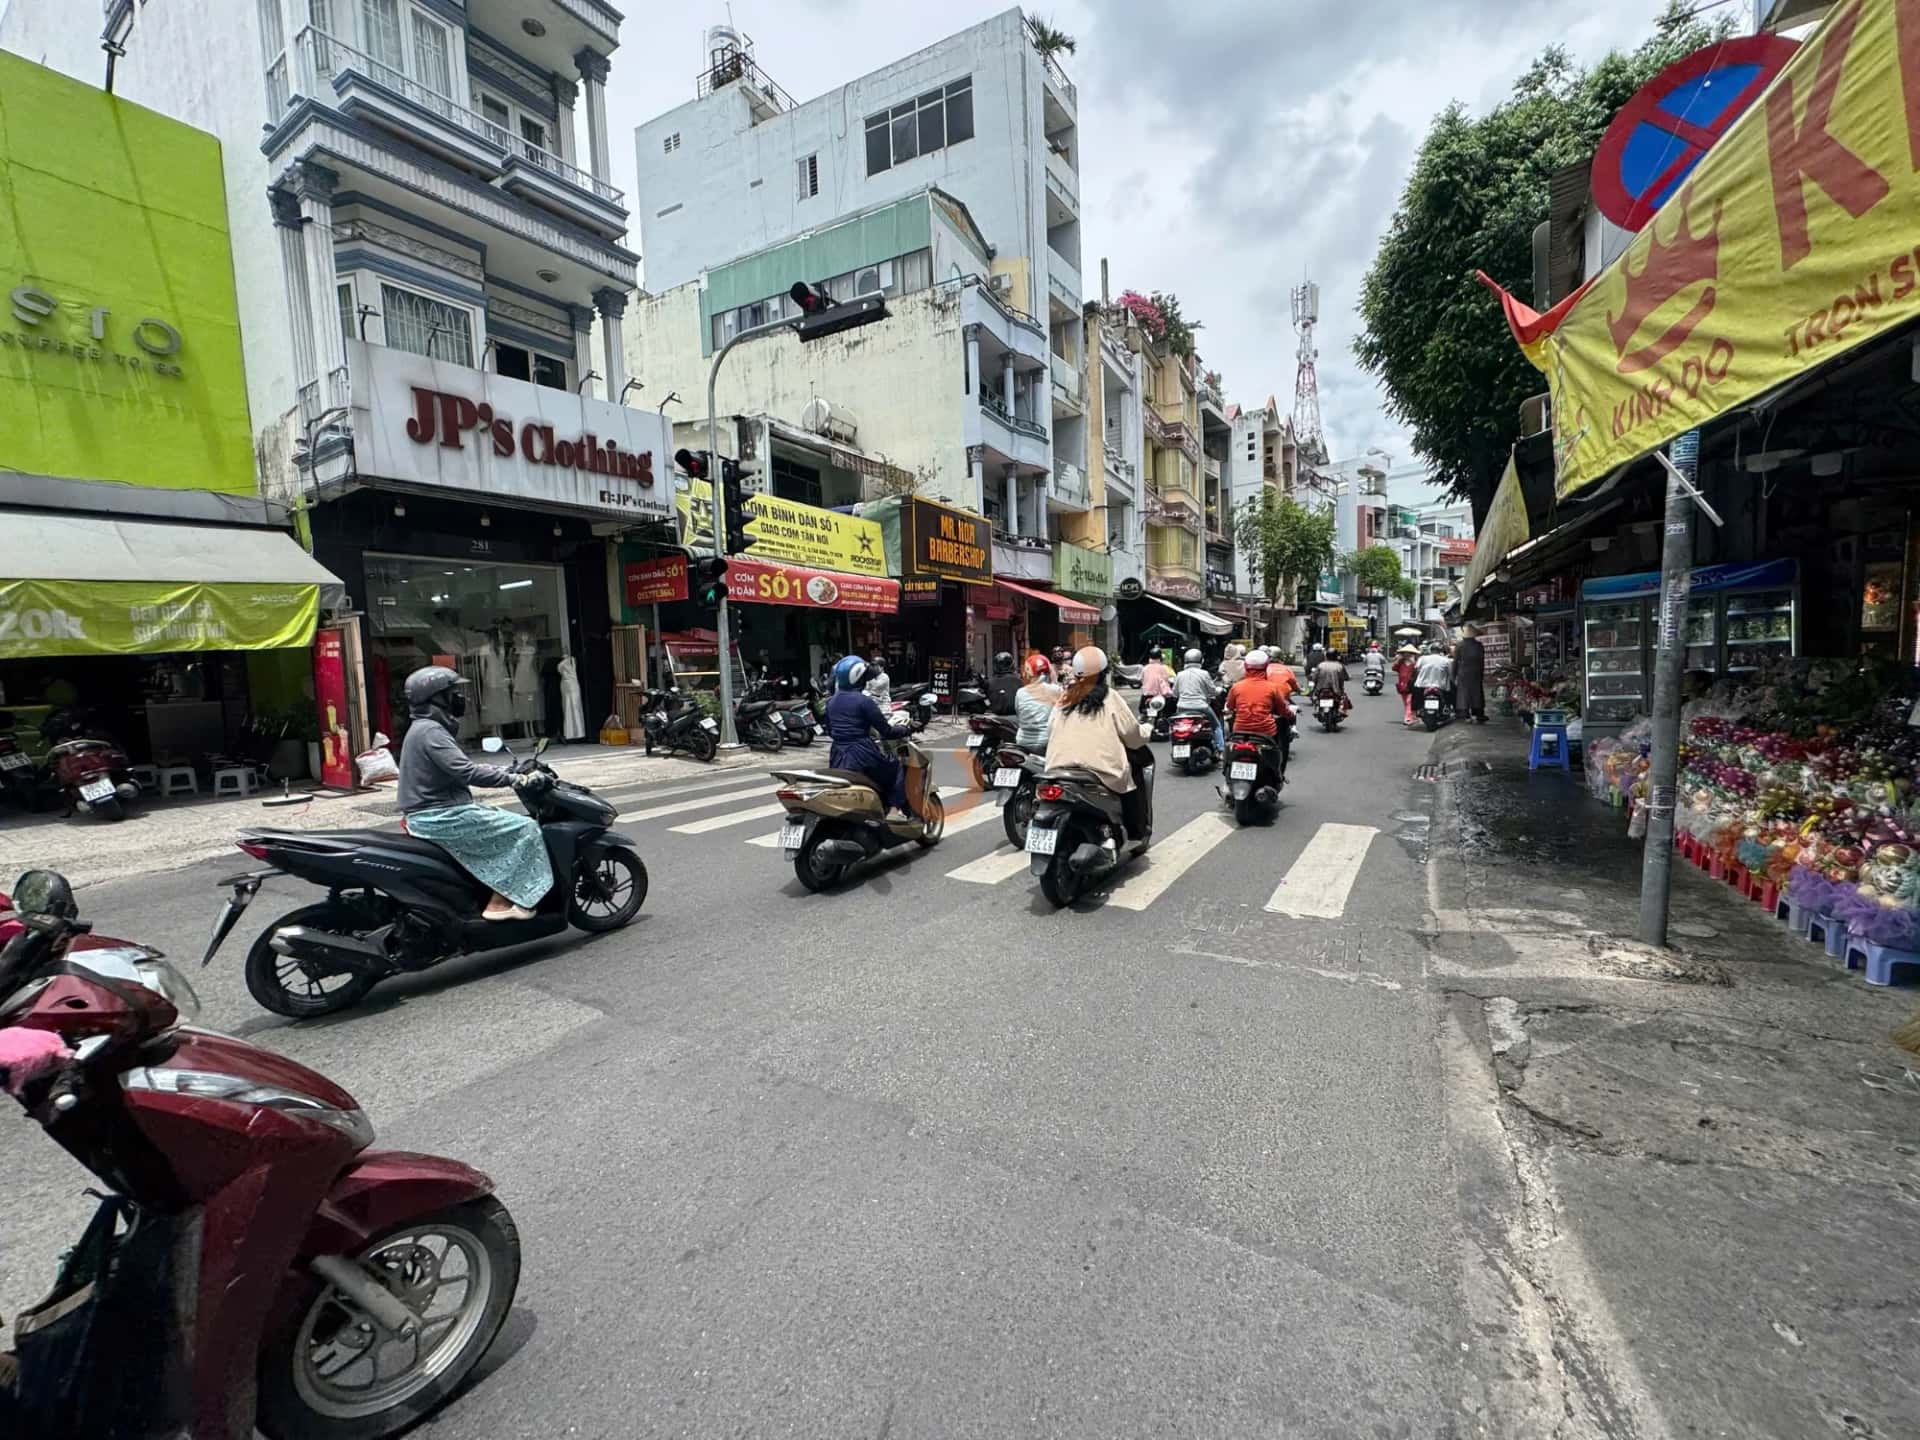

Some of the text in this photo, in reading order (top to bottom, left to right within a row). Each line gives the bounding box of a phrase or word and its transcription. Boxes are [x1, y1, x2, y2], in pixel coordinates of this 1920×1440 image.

[520, 423, 655, 488] Clothing
[760, 522, 780, 535] GIAO
[771, 504, 797, 523] BÌNH
[798, 511, 818, 529] DÂN
[820, 515, 832, 532] SỐ
[834, 521, 840, 534] 1
[929, 536, 986, 569] BARBERSHOP
[758, 569, 802, 600] SỐ 1
